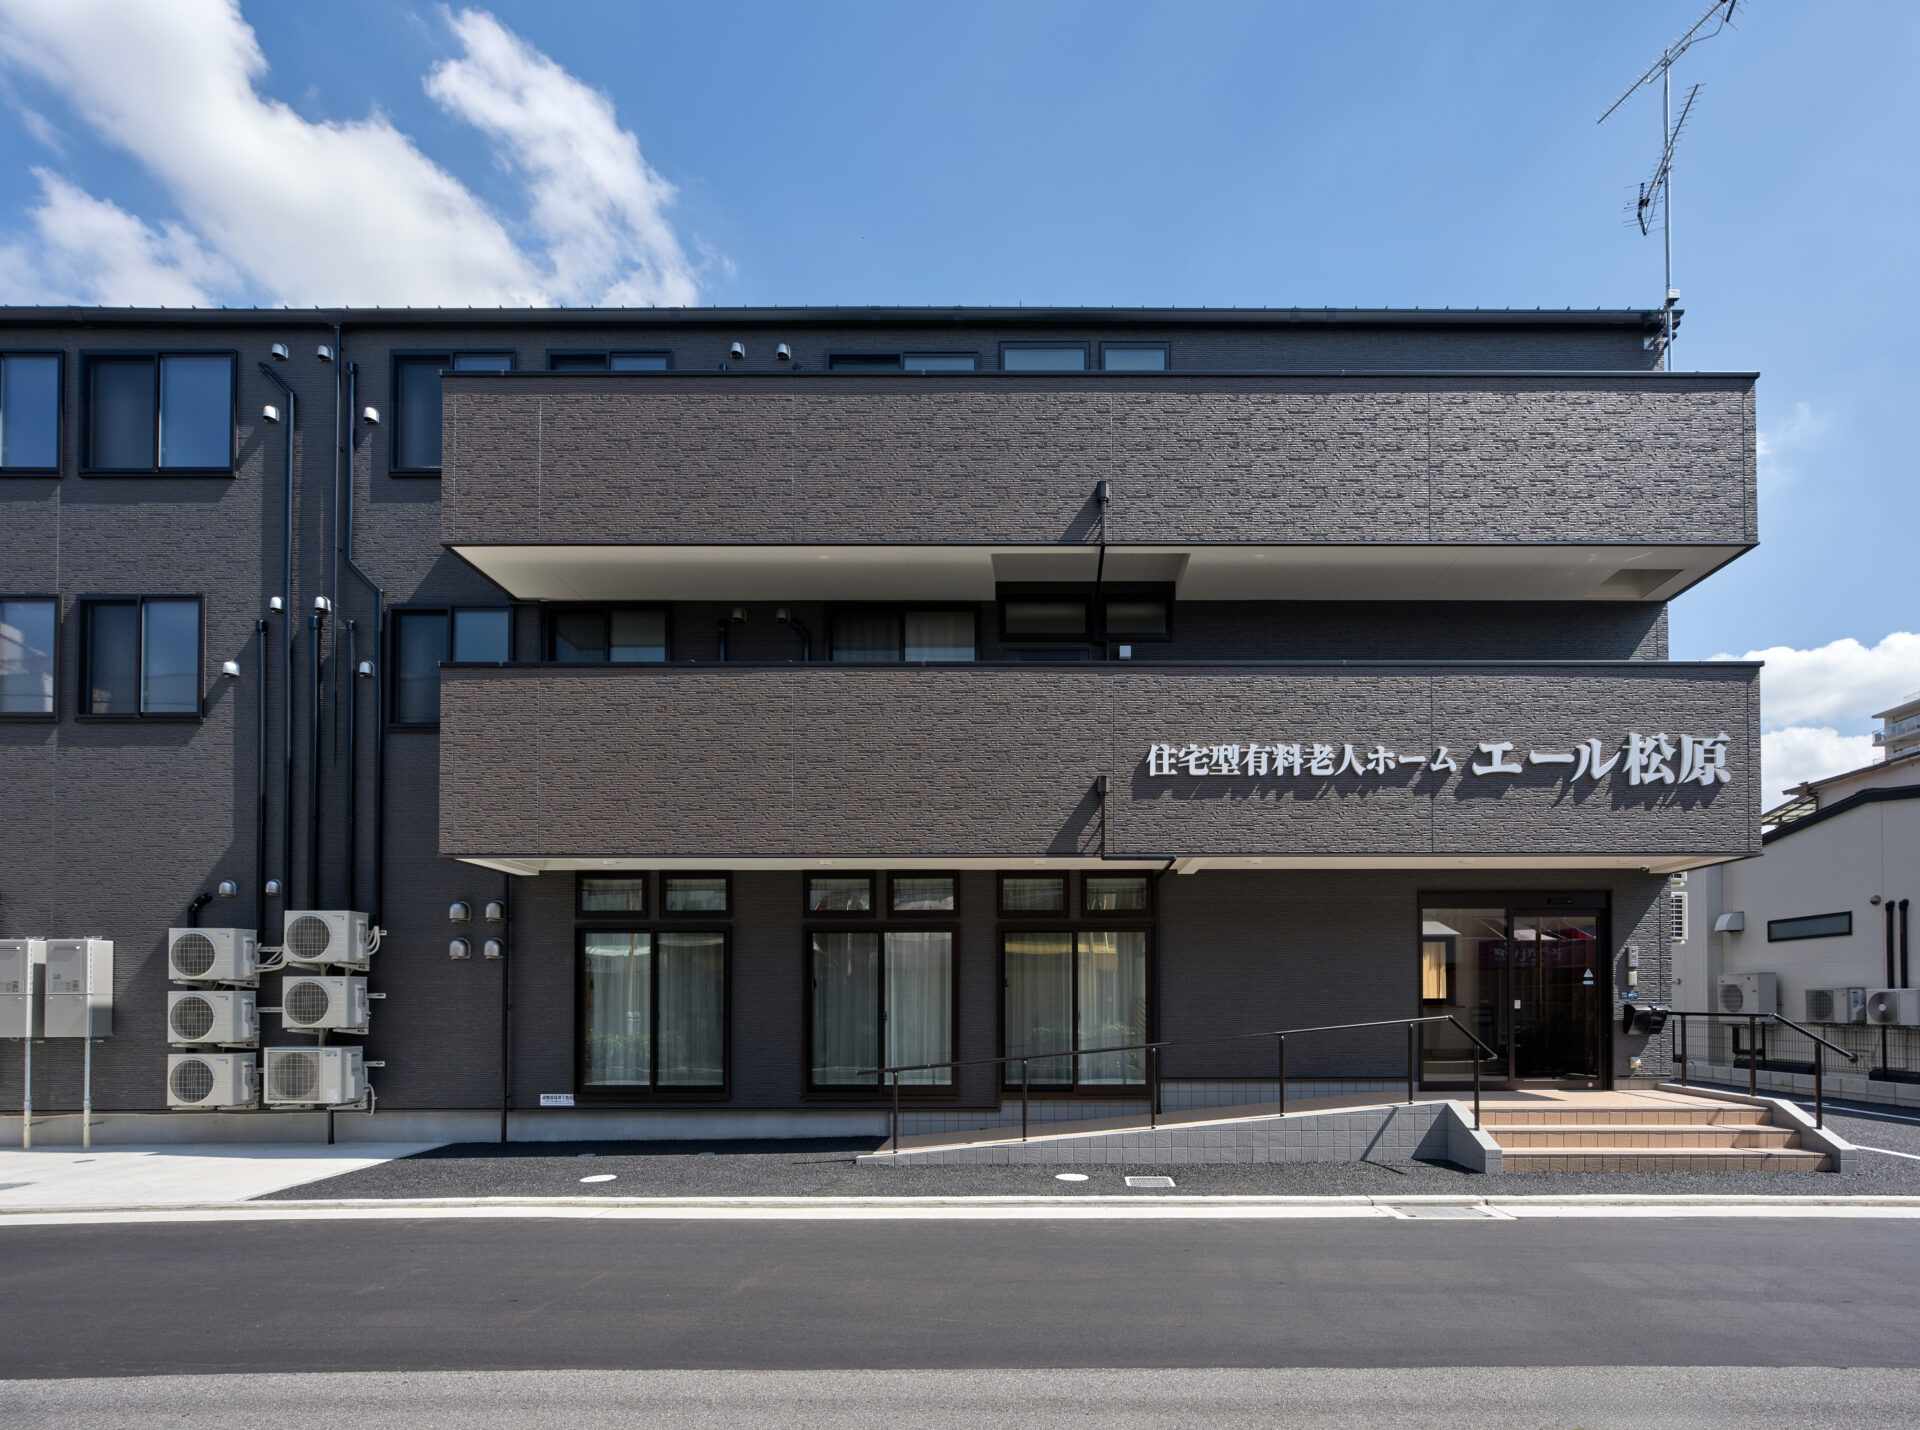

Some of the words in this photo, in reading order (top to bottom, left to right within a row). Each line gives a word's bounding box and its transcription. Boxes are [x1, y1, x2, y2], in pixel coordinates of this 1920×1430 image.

[1146, 743, 1457, 777] 住宅型有料老人ホーム
[1472, 732, 1732, 786] エール松原
